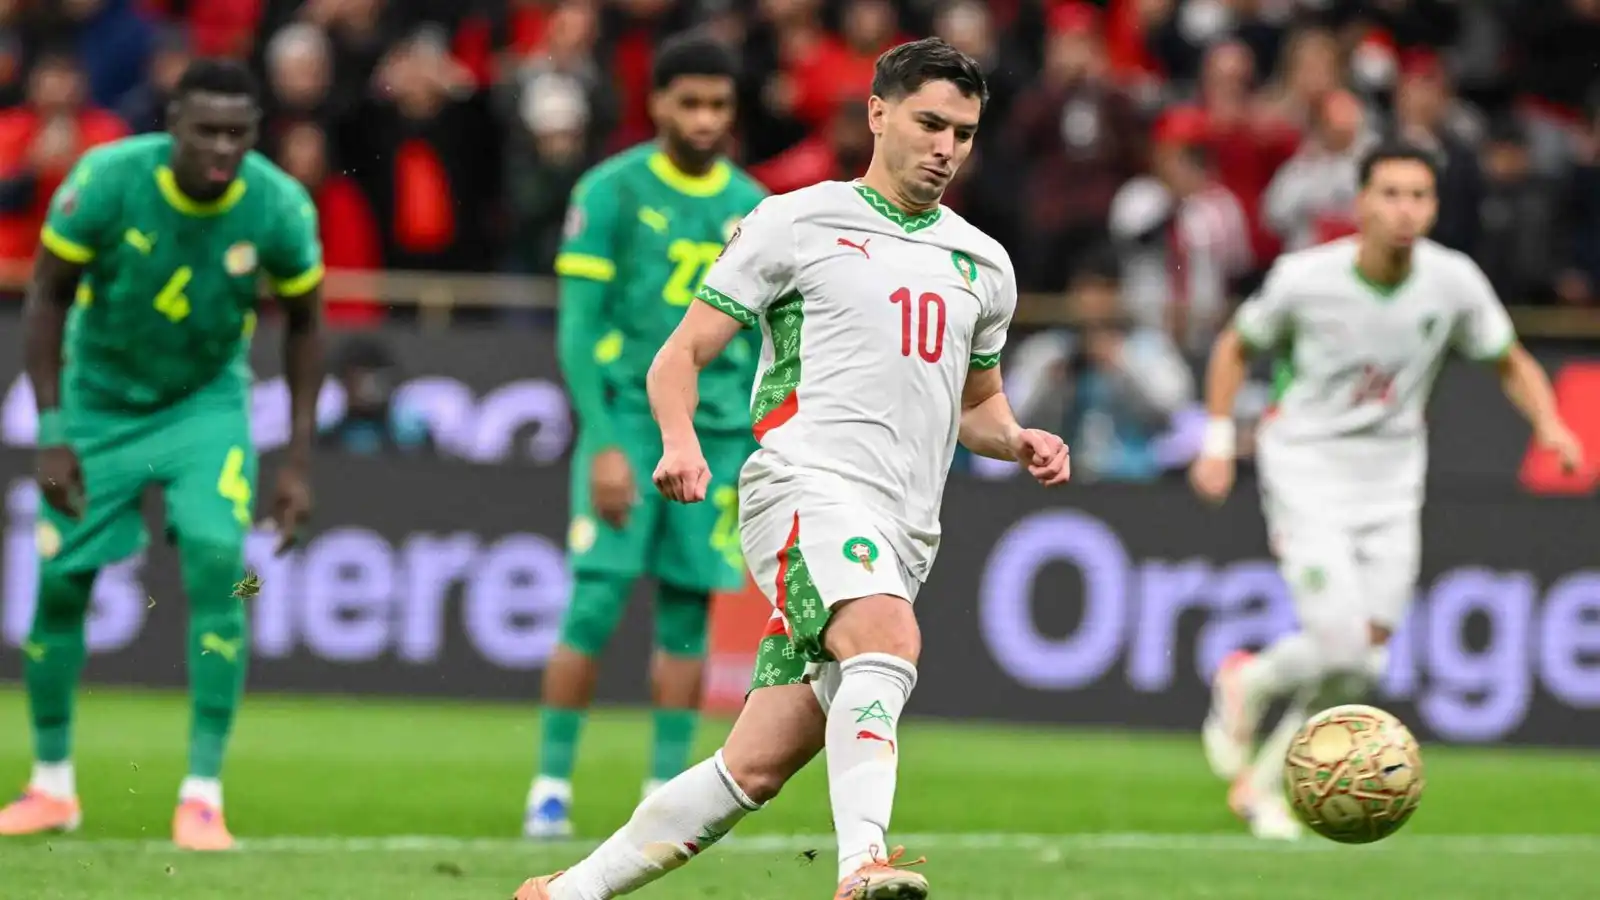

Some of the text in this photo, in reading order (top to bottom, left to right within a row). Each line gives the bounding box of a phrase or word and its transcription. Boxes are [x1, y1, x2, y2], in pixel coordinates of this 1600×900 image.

[152, 265, 193, 324] 4
[889, 287, 946, 363] 10
[217, 445, 252, 526] 4
[980, 508, 1600, 742] Orage
